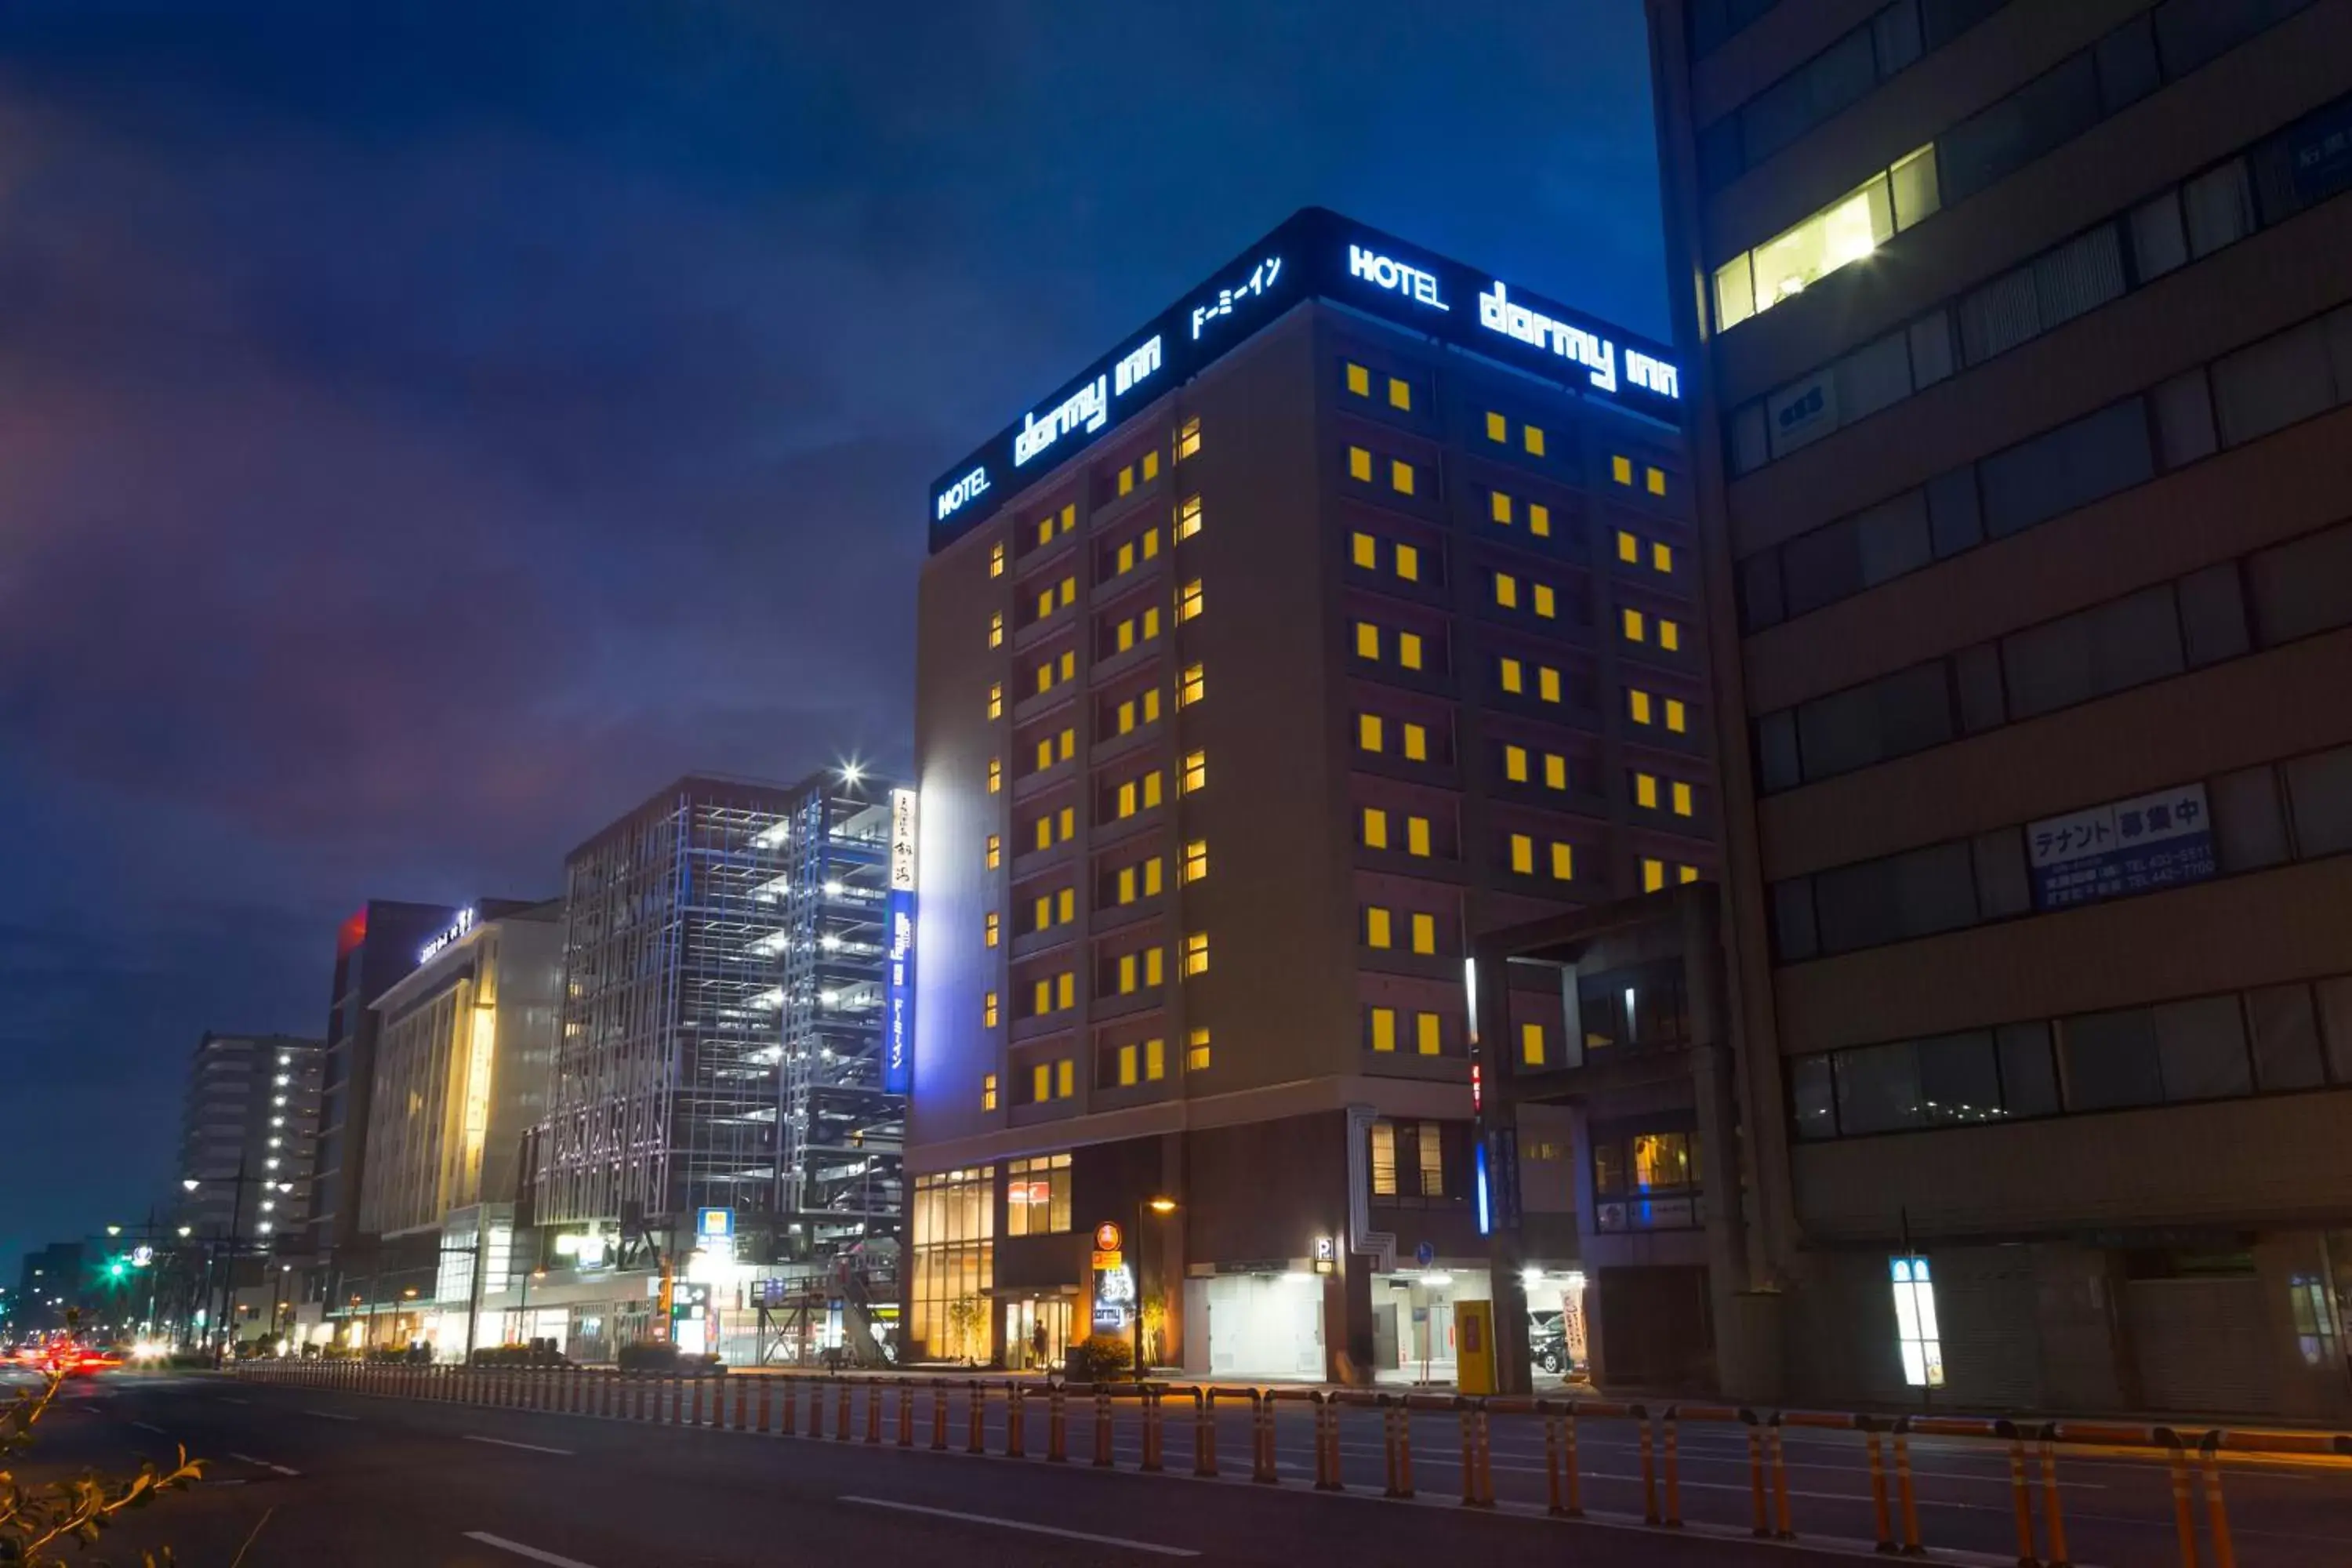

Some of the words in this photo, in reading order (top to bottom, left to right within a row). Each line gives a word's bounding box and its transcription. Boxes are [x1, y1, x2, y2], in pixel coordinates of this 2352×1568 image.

[1193, 258, 1281, 339] ドーミーイン
[1350, 245, 1449, 310] HOTEL
[1479, 281, 1617, 392] dormy
[1625, 349, 1679, 398] inn
[938, 467, 990, 520] HOTEL
[1015, 374, 1106, 467] dormy
[1116, 335, 1161, 396] inn
[1319, 1239, 1330, 1258] P
